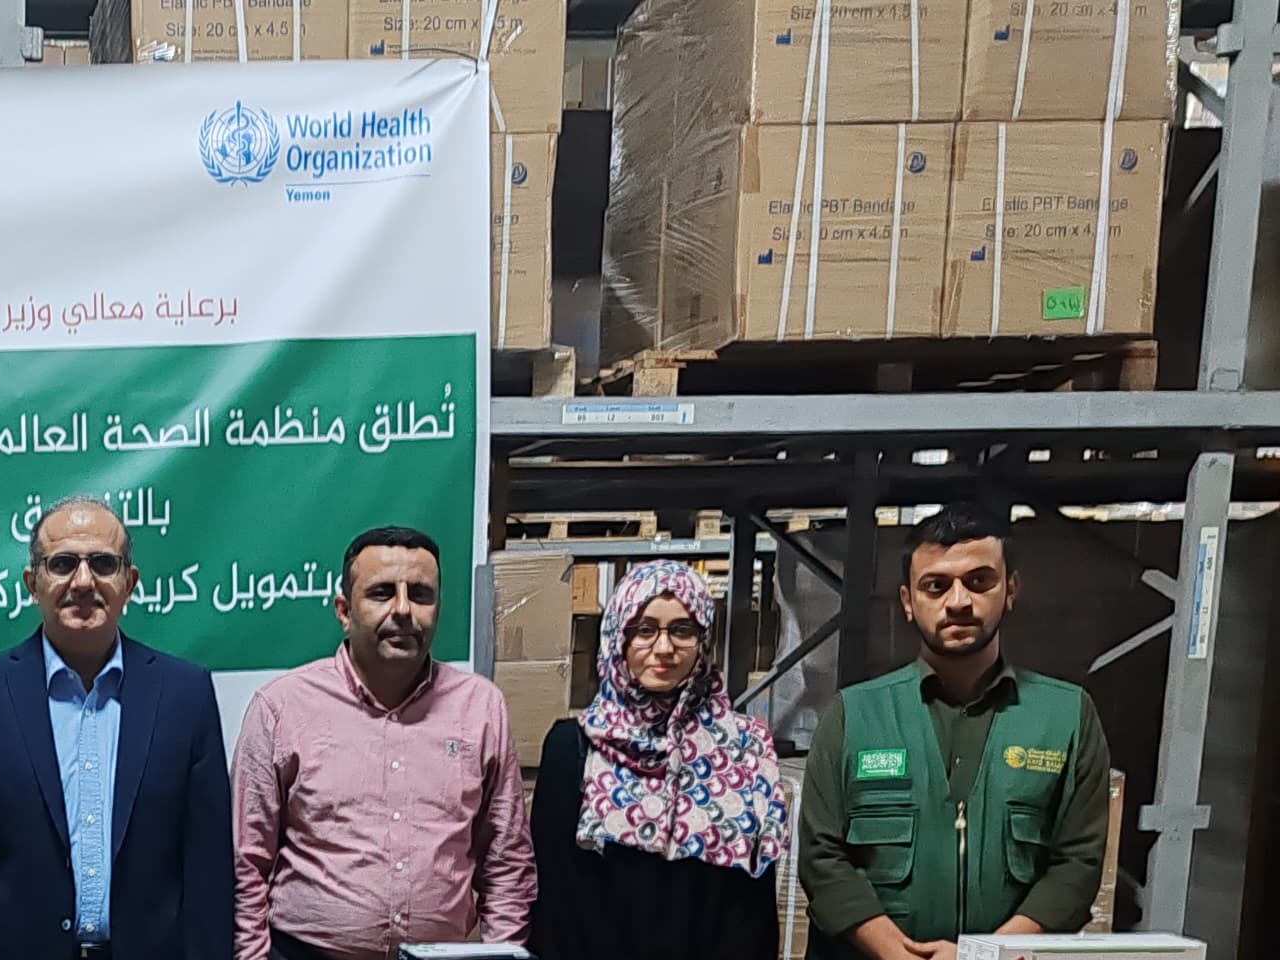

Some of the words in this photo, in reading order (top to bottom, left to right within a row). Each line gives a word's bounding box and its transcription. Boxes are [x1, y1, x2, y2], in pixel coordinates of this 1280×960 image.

[423, 17, 441, 31] 20
[445, 19, 467, 30] cm
[287, 111, 351, 140] World
[361, 109, 432, 138] Health
[286, 141, 432, 178] Organization
[286, 188, 331, 202] Yemen
[1033, 196, 1064, 210] PBT
[833, 230, 853, 240] cm
[1024, 224, 1041, 238] 20
[1046, 226, 1066, 238] cm
[2, 298, 52, 332] وزير
[62, 293, 144, 334] معالي
[155, 290, 238, 325] برعاية
[103, 406, 210, 452] الصحة
[226, 405, 346, 448] منظمة
